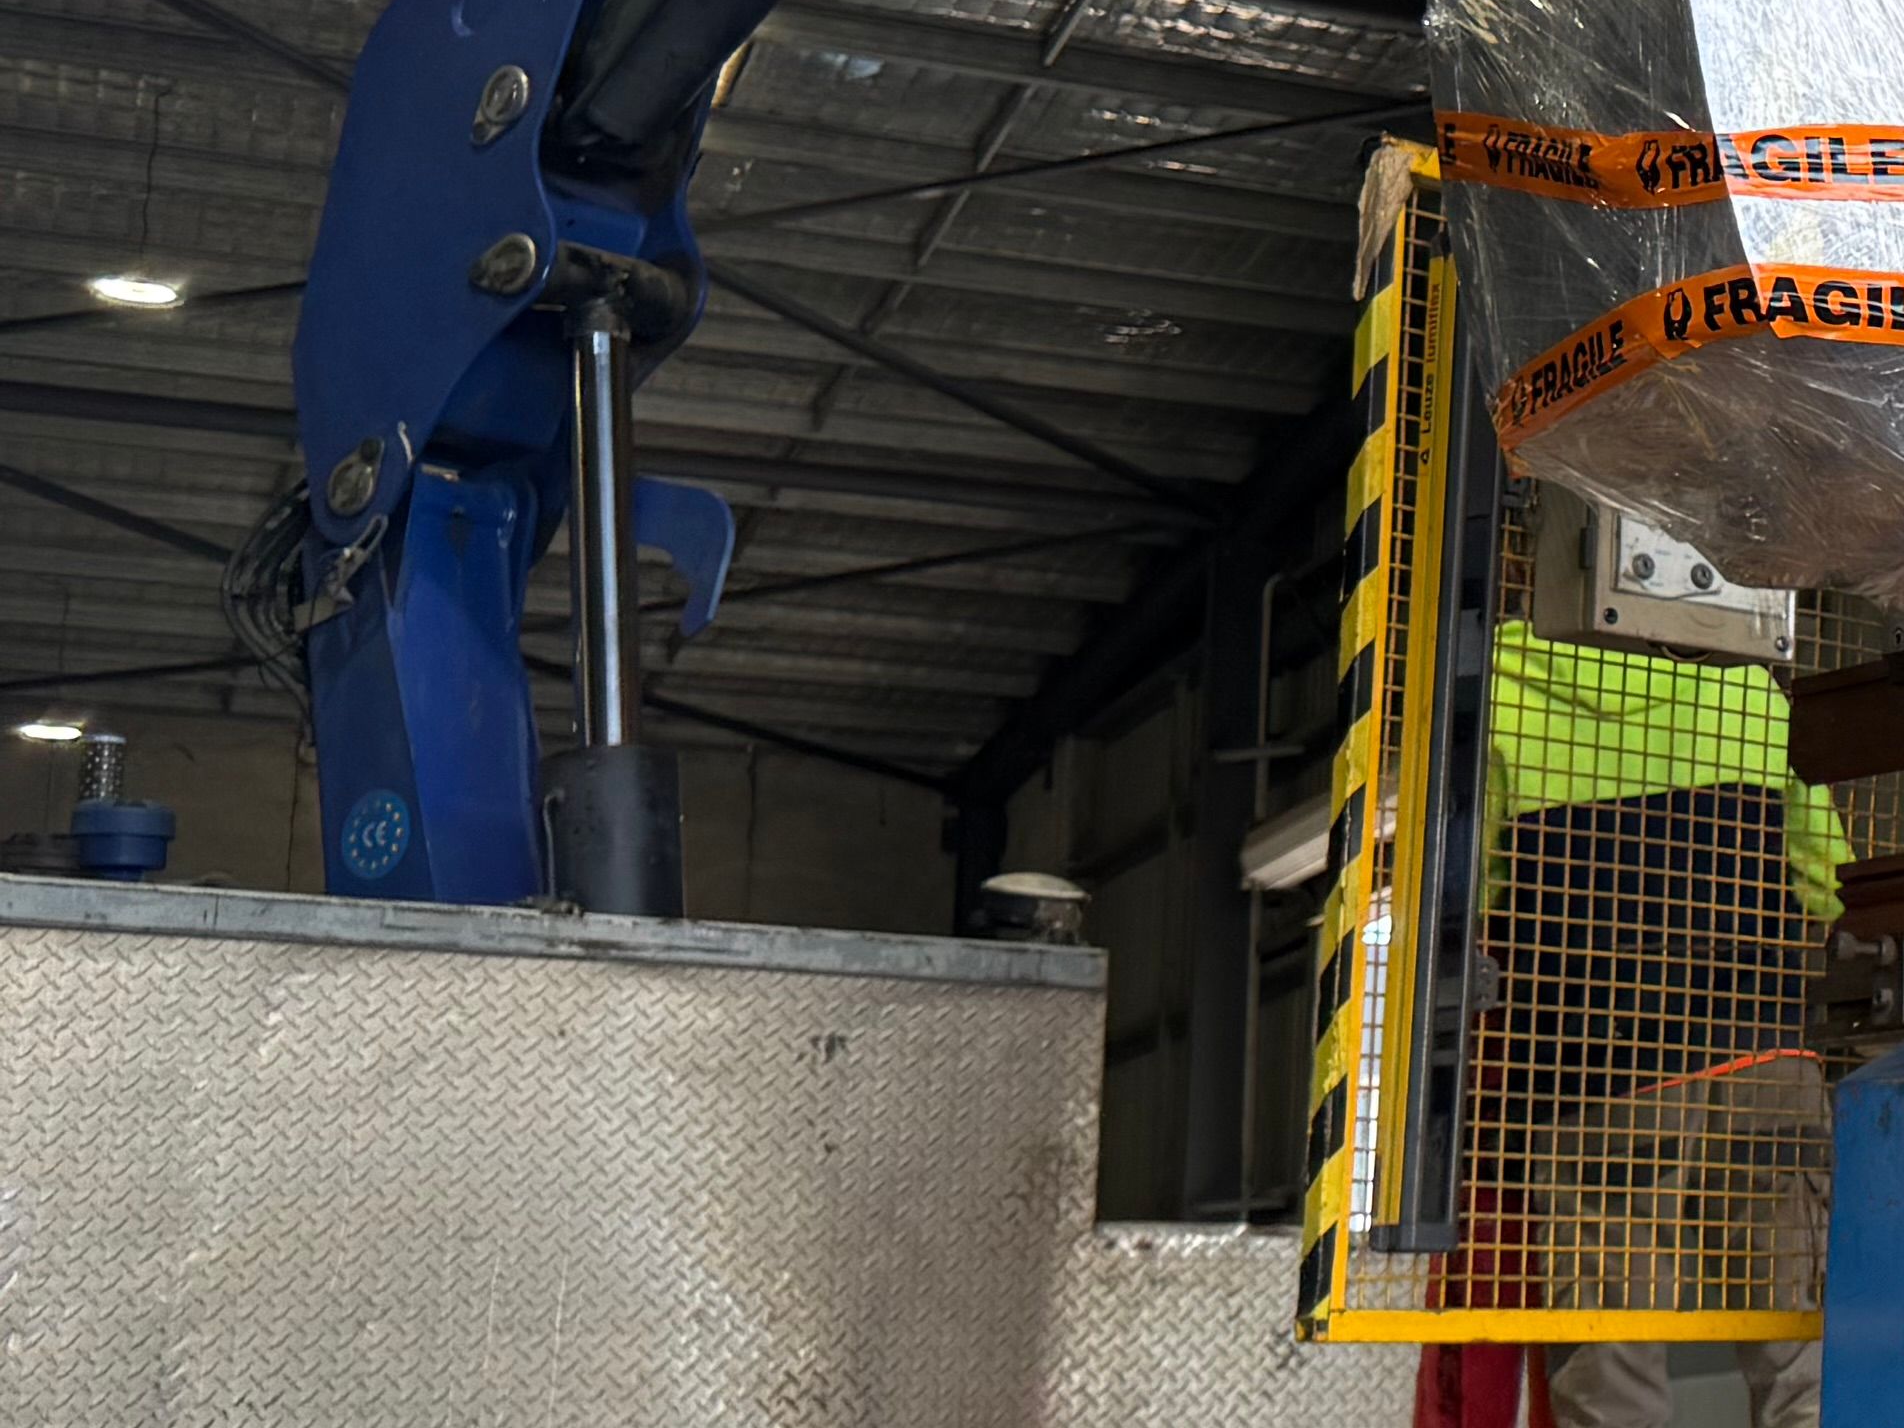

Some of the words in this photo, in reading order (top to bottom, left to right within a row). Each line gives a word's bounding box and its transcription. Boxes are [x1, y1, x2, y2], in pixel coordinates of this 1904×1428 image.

[1531, 320, 1626, 414] FRAGILE
[1421, 373, 1435, 434] Leuze
[361, 820, 388, 849] CE
